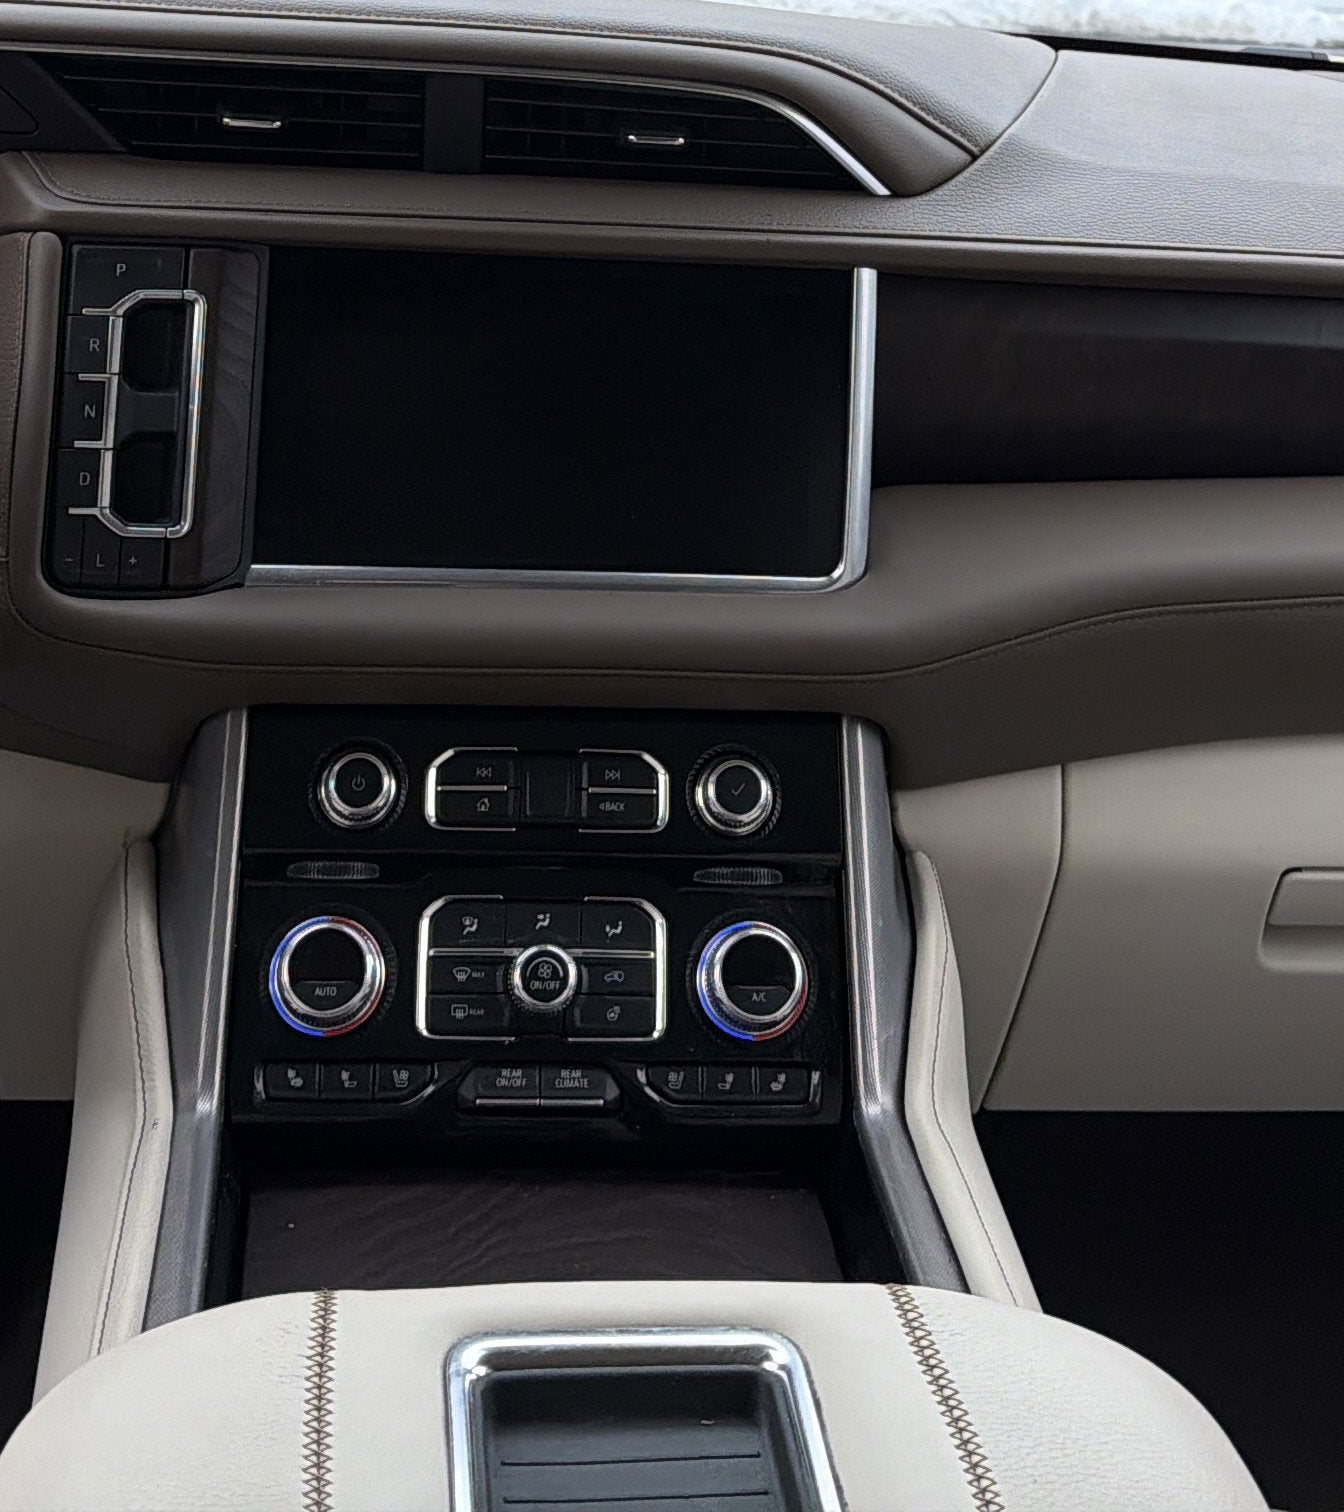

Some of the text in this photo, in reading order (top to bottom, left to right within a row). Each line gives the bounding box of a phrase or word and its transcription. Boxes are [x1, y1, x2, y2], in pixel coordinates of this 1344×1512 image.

[116, 264, 126, 276] P
[89, 339, 100, 352] R
[84, 405, 96, 418] N
[79, 472, 90, 486] D
[96, 553, 104, 567] L
[605, 801, 625, 811] BACK
[529, 980, 561, 990] ON/OFF
[314, 986, 337, 996] AUTO
[751, 991, 767, 1002] A/C
[469, 1008, 485, 1016] REAR
[501, 1069, 522, 1078] REAR
[560, 1068, 582, 1078] REAR
[496, 1078, 527, 1088] ON/OFF
[555, 1078, 589, 1088] CLIMATE
